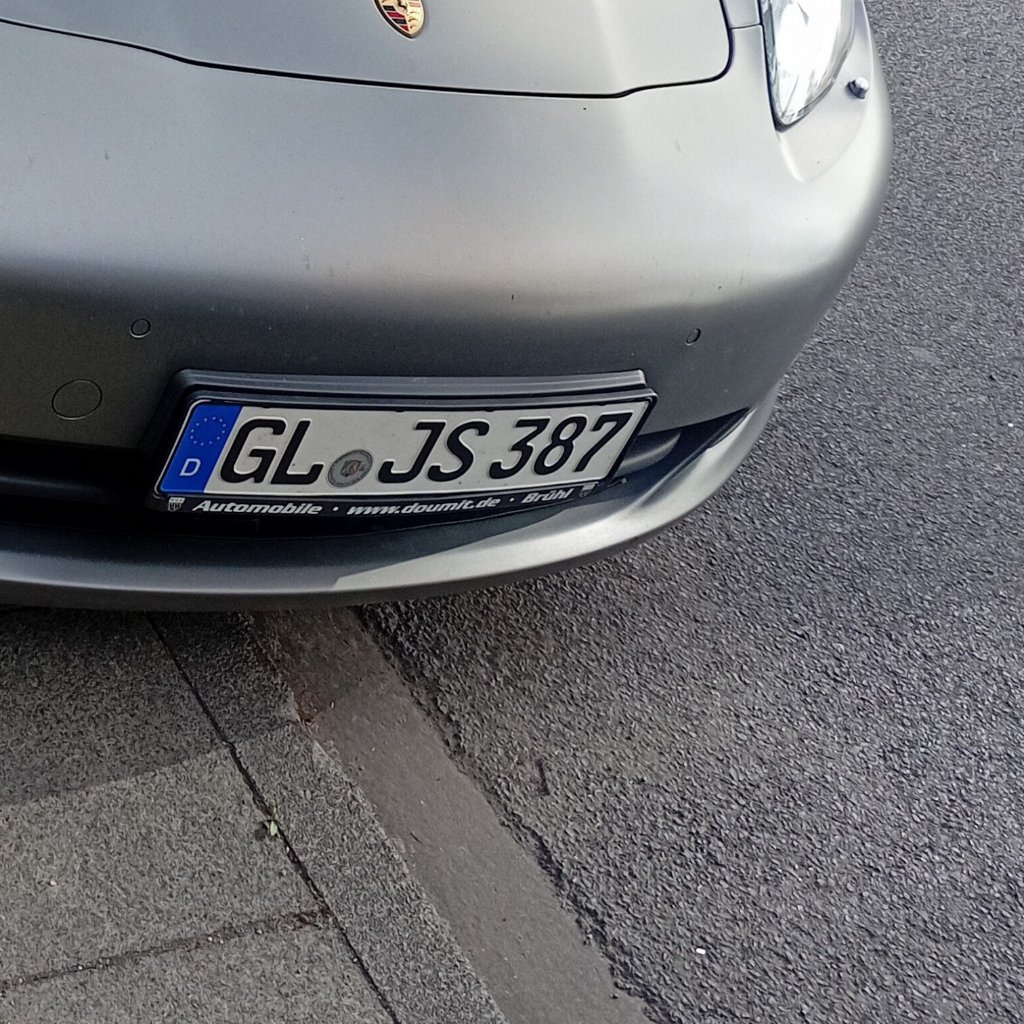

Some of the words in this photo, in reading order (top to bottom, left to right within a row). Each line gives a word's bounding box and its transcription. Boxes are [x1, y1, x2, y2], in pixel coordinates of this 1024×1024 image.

[217, 418, 324, 487] GL
[377, 419, 491, 484] JS
[489, 411, 634, 481] 387
[179, 457, 201, 477] D
[191, 499, 324, 515] Automobile
[346, 495, 502, 516] www.doumit.de
[521, 487, 575, 504] Brühl
